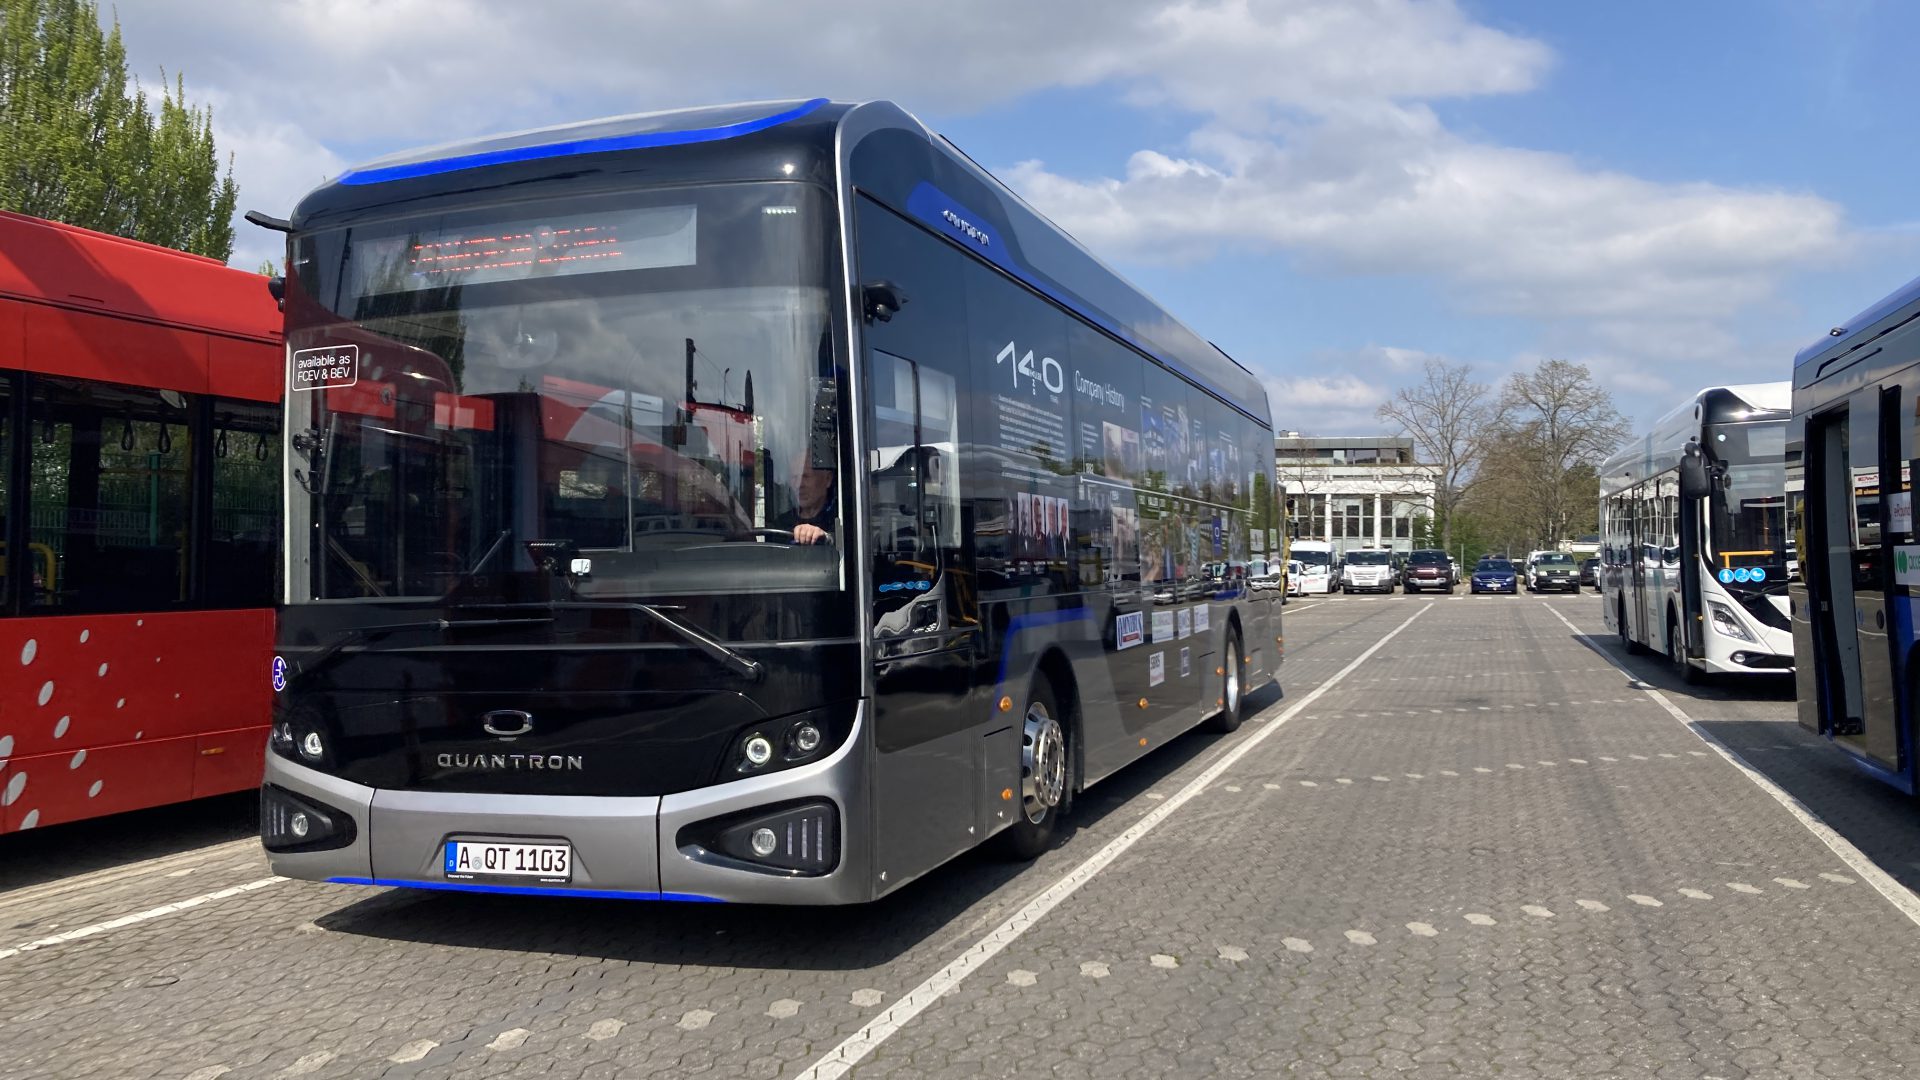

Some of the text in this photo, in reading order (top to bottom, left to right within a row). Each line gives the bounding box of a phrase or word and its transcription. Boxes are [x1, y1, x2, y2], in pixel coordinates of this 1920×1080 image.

[298, 354, 351, 369] available as
[996, 340, 1064, 394] 140
[297, 366, 350, 382] FCEV & BEV
[1075, 369, 1104, 406] Company
[1105, 384, 1125, 413] History
[437, 753, 583, 770] QUANTRON
[458, 846, 567, 872] A QT 1103
